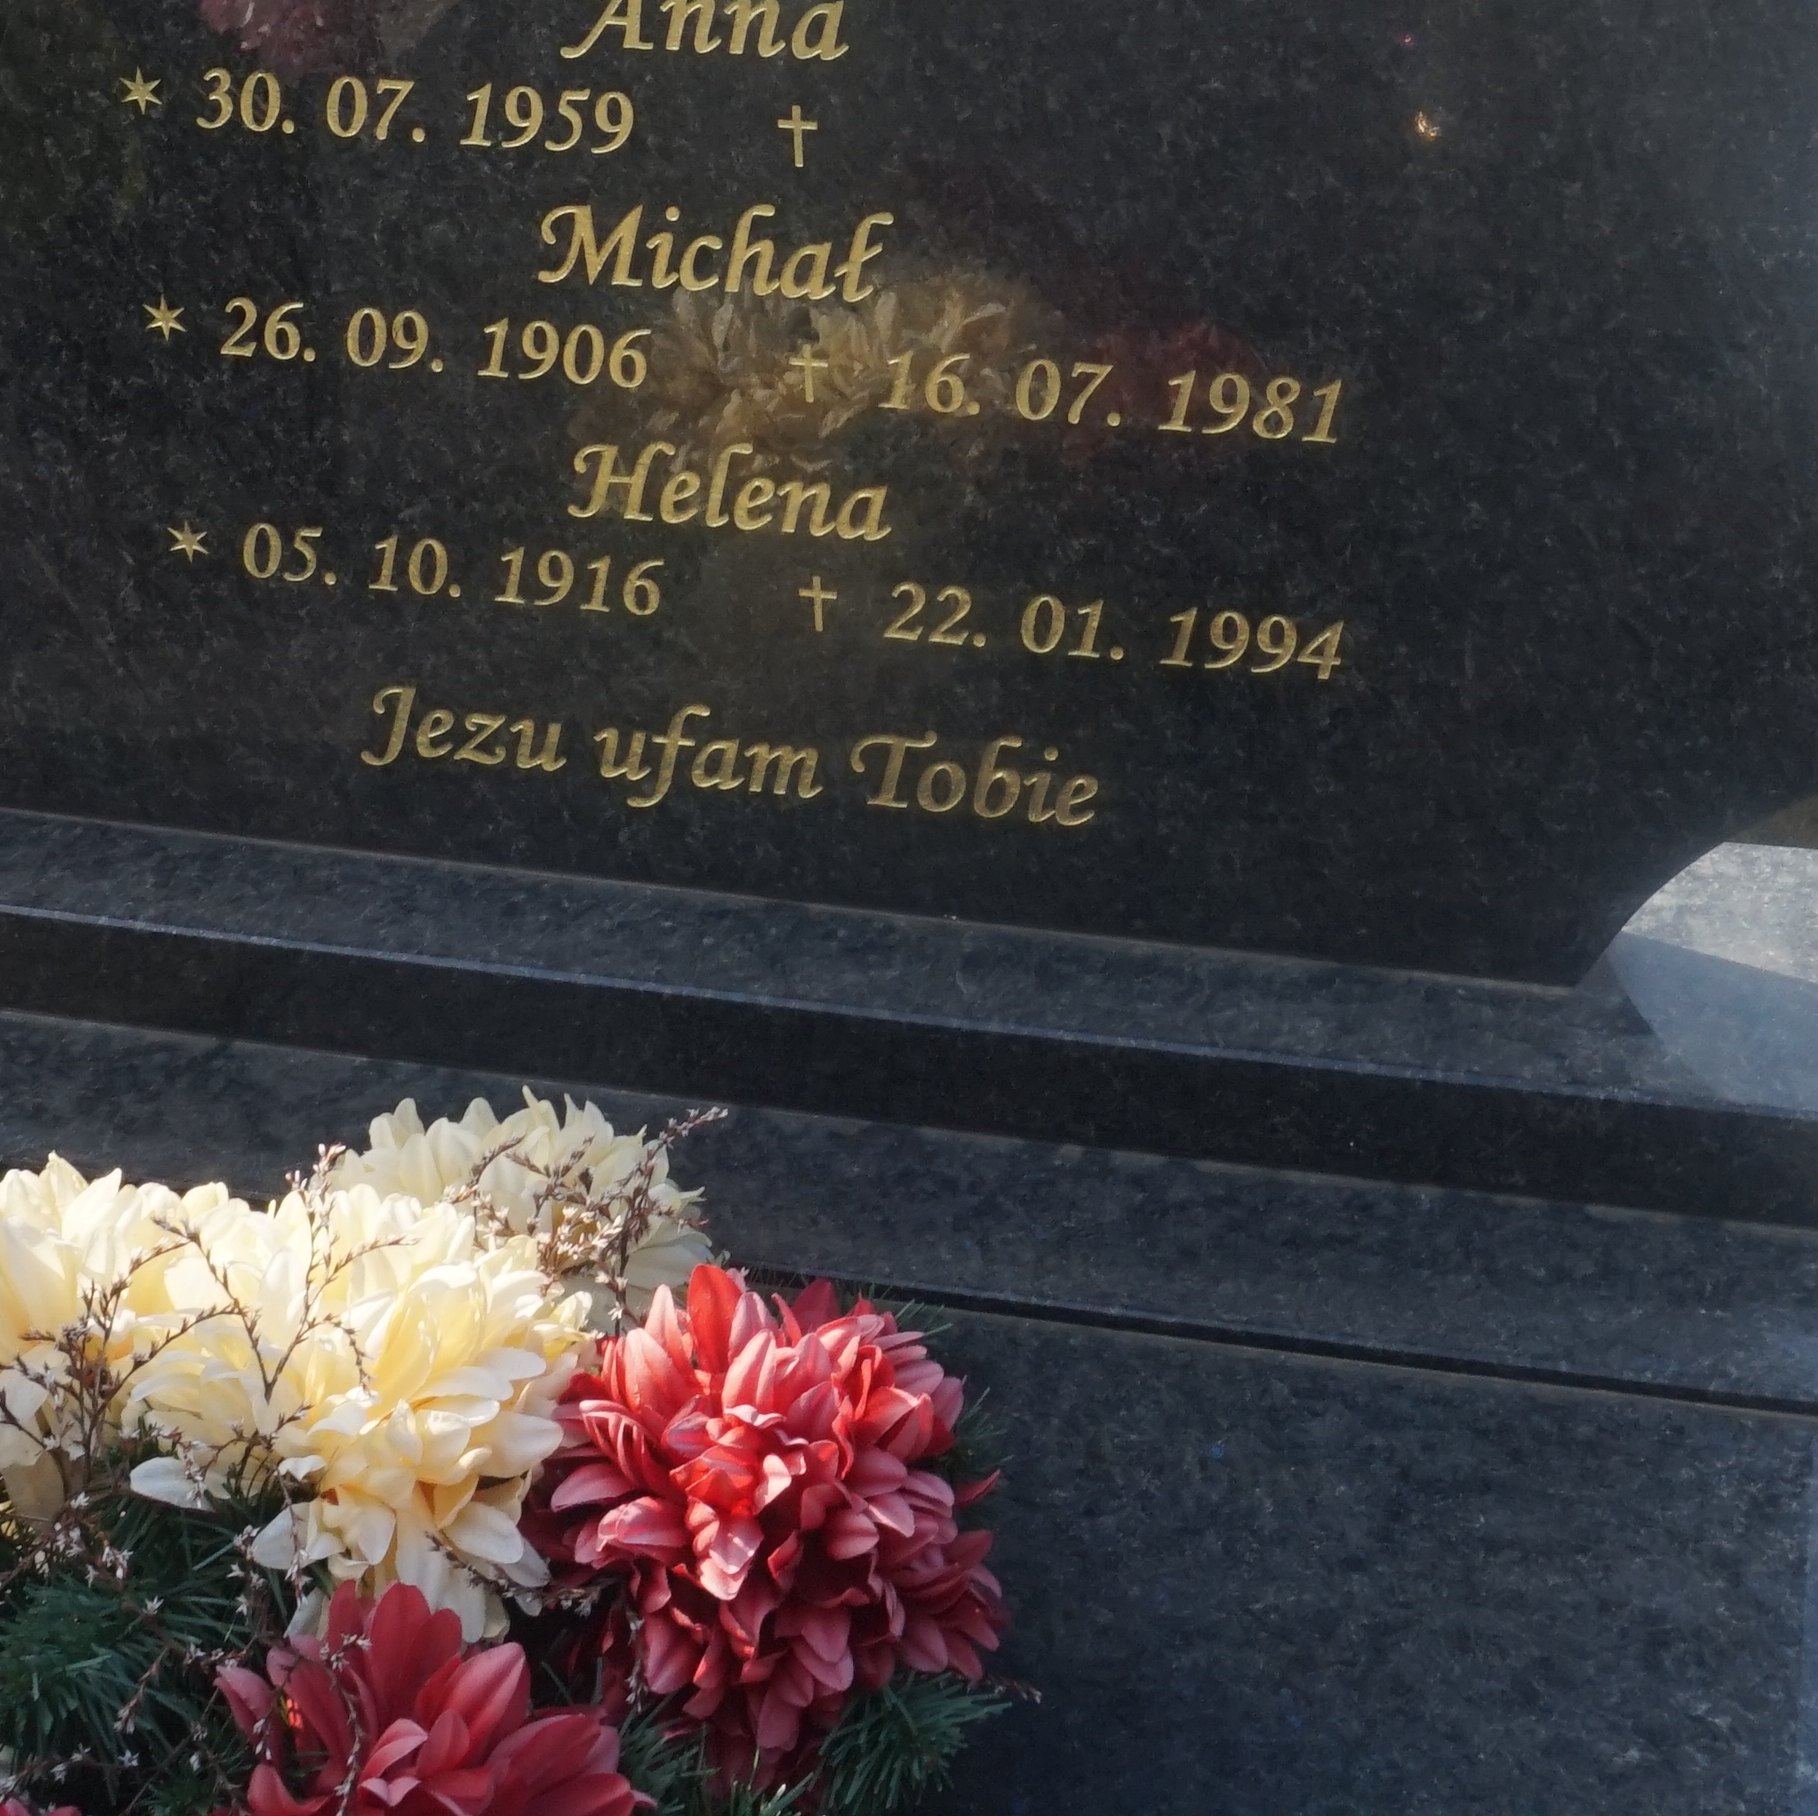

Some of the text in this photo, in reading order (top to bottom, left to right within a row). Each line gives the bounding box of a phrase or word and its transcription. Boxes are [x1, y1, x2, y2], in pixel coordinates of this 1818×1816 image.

[536, 204, 896, 304] Michał
[566, 441, 892, 541] Helena
[361, 683, 1099, 827] Jezu ufam Tobie
